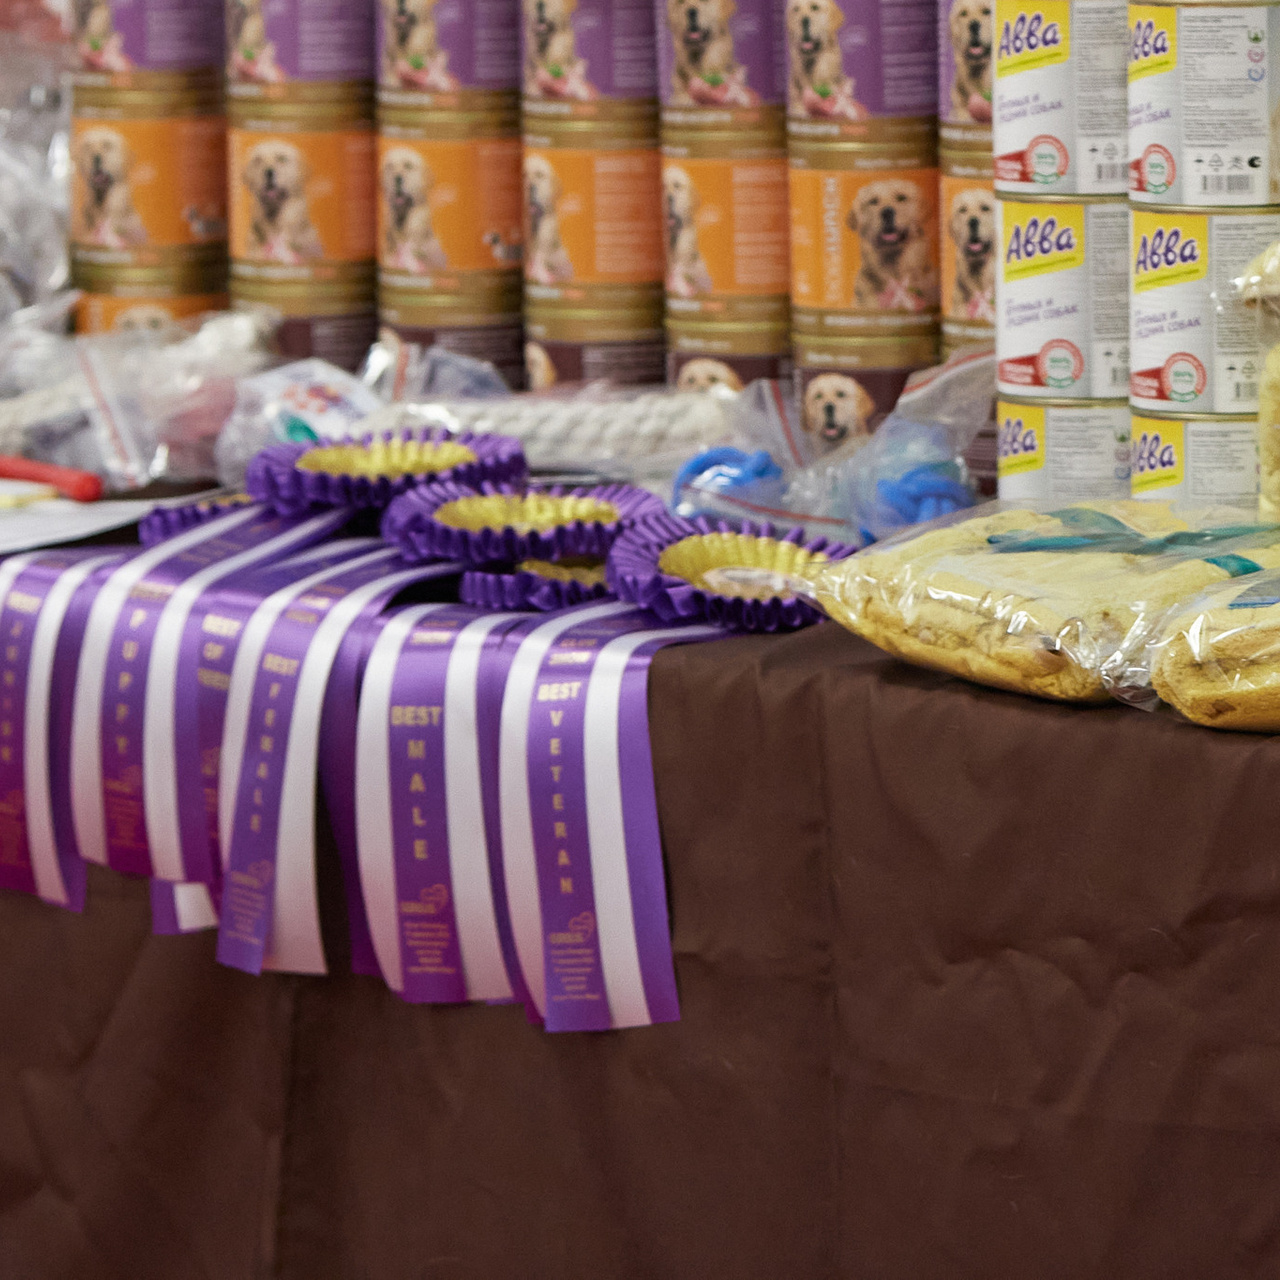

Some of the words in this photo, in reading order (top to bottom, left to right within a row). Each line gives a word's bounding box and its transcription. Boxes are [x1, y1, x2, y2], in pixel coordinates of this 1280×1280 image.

[390, 705, 442, 727] BEST
[536, 681, 582, 702] BEST
[406, 738, 428, 860] MALE
[548, 709, 575, 894] VETERAN
